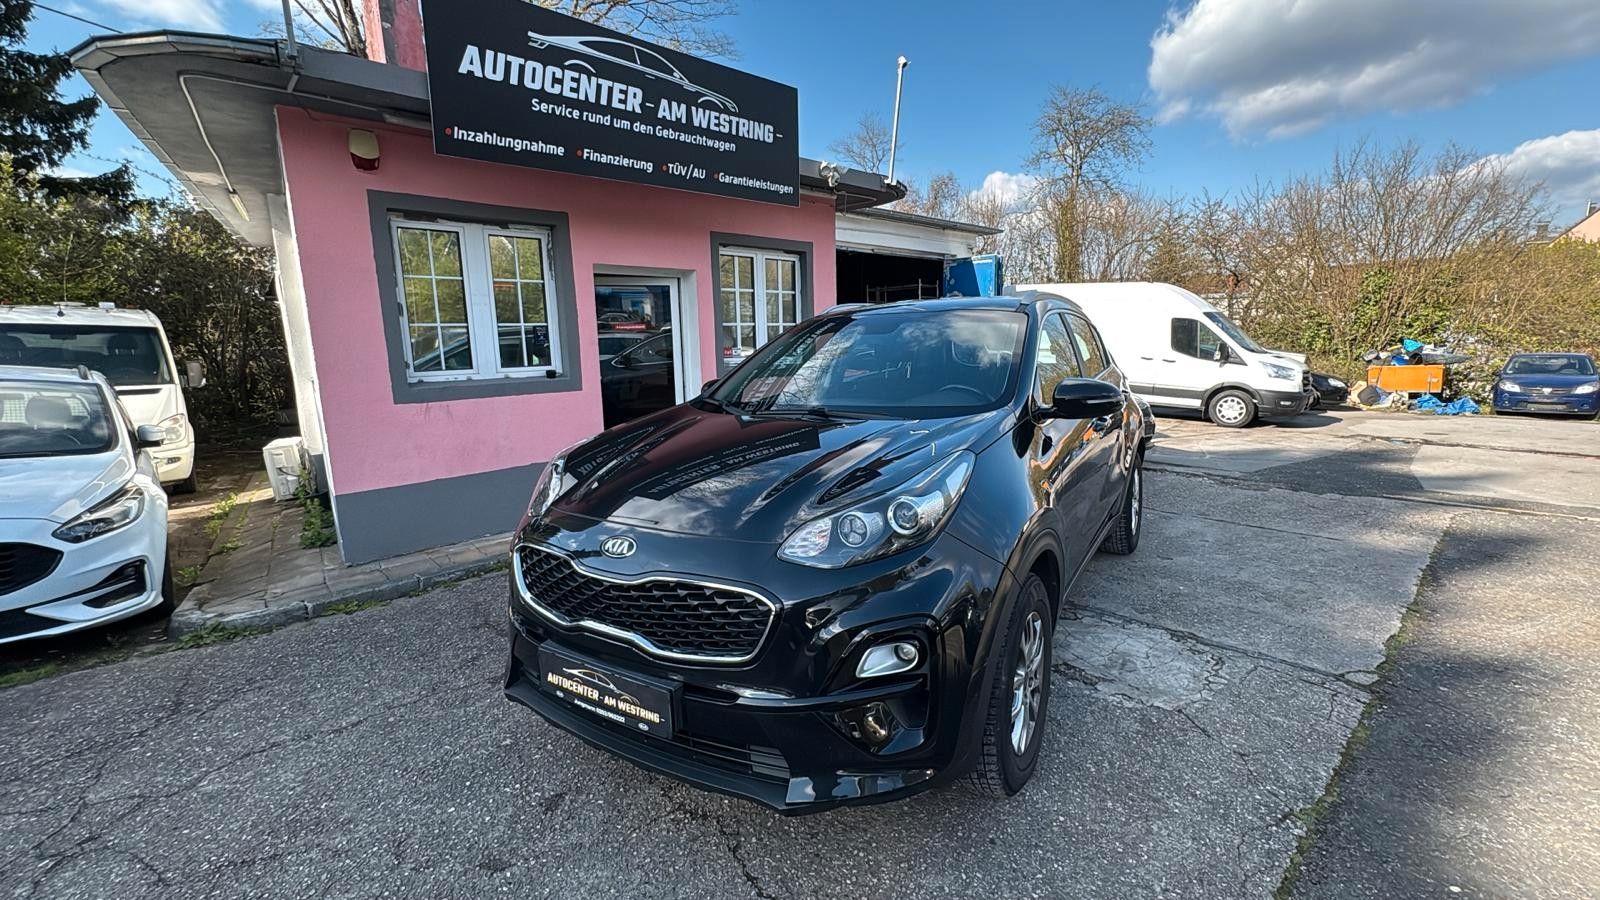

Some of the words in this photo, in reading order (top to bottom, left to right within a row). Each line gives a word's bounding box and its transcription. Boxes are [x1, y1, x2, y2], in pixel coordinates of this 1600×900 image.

[458, 44, 643, 113] AUTOCENTER
[658, 98, 686, 124] AM
[691, 106, 774, 144] WESTRING
[531, 98, 580, 120] Service
[583, 110, 611, 126] rund
[613, 118, 631, 130] um
[633, 120, 654, 135] den
[656, 126, 736, 153] Gebrauchtwagen
[453, 126, 565, 156] Inzahlungnahme
[583, 149, 654, 173] Finanzierung
[668, 162, 706, 180] TÜV/AU
[719, 172, 793, 194] Garantieleistungen
[605, 538, 630, 554] KIA
[547, 672, 599, 700] AUTOCENTER
[604, 696, 616, 707] AM
[618, 700, 660, 723] WESTRING
